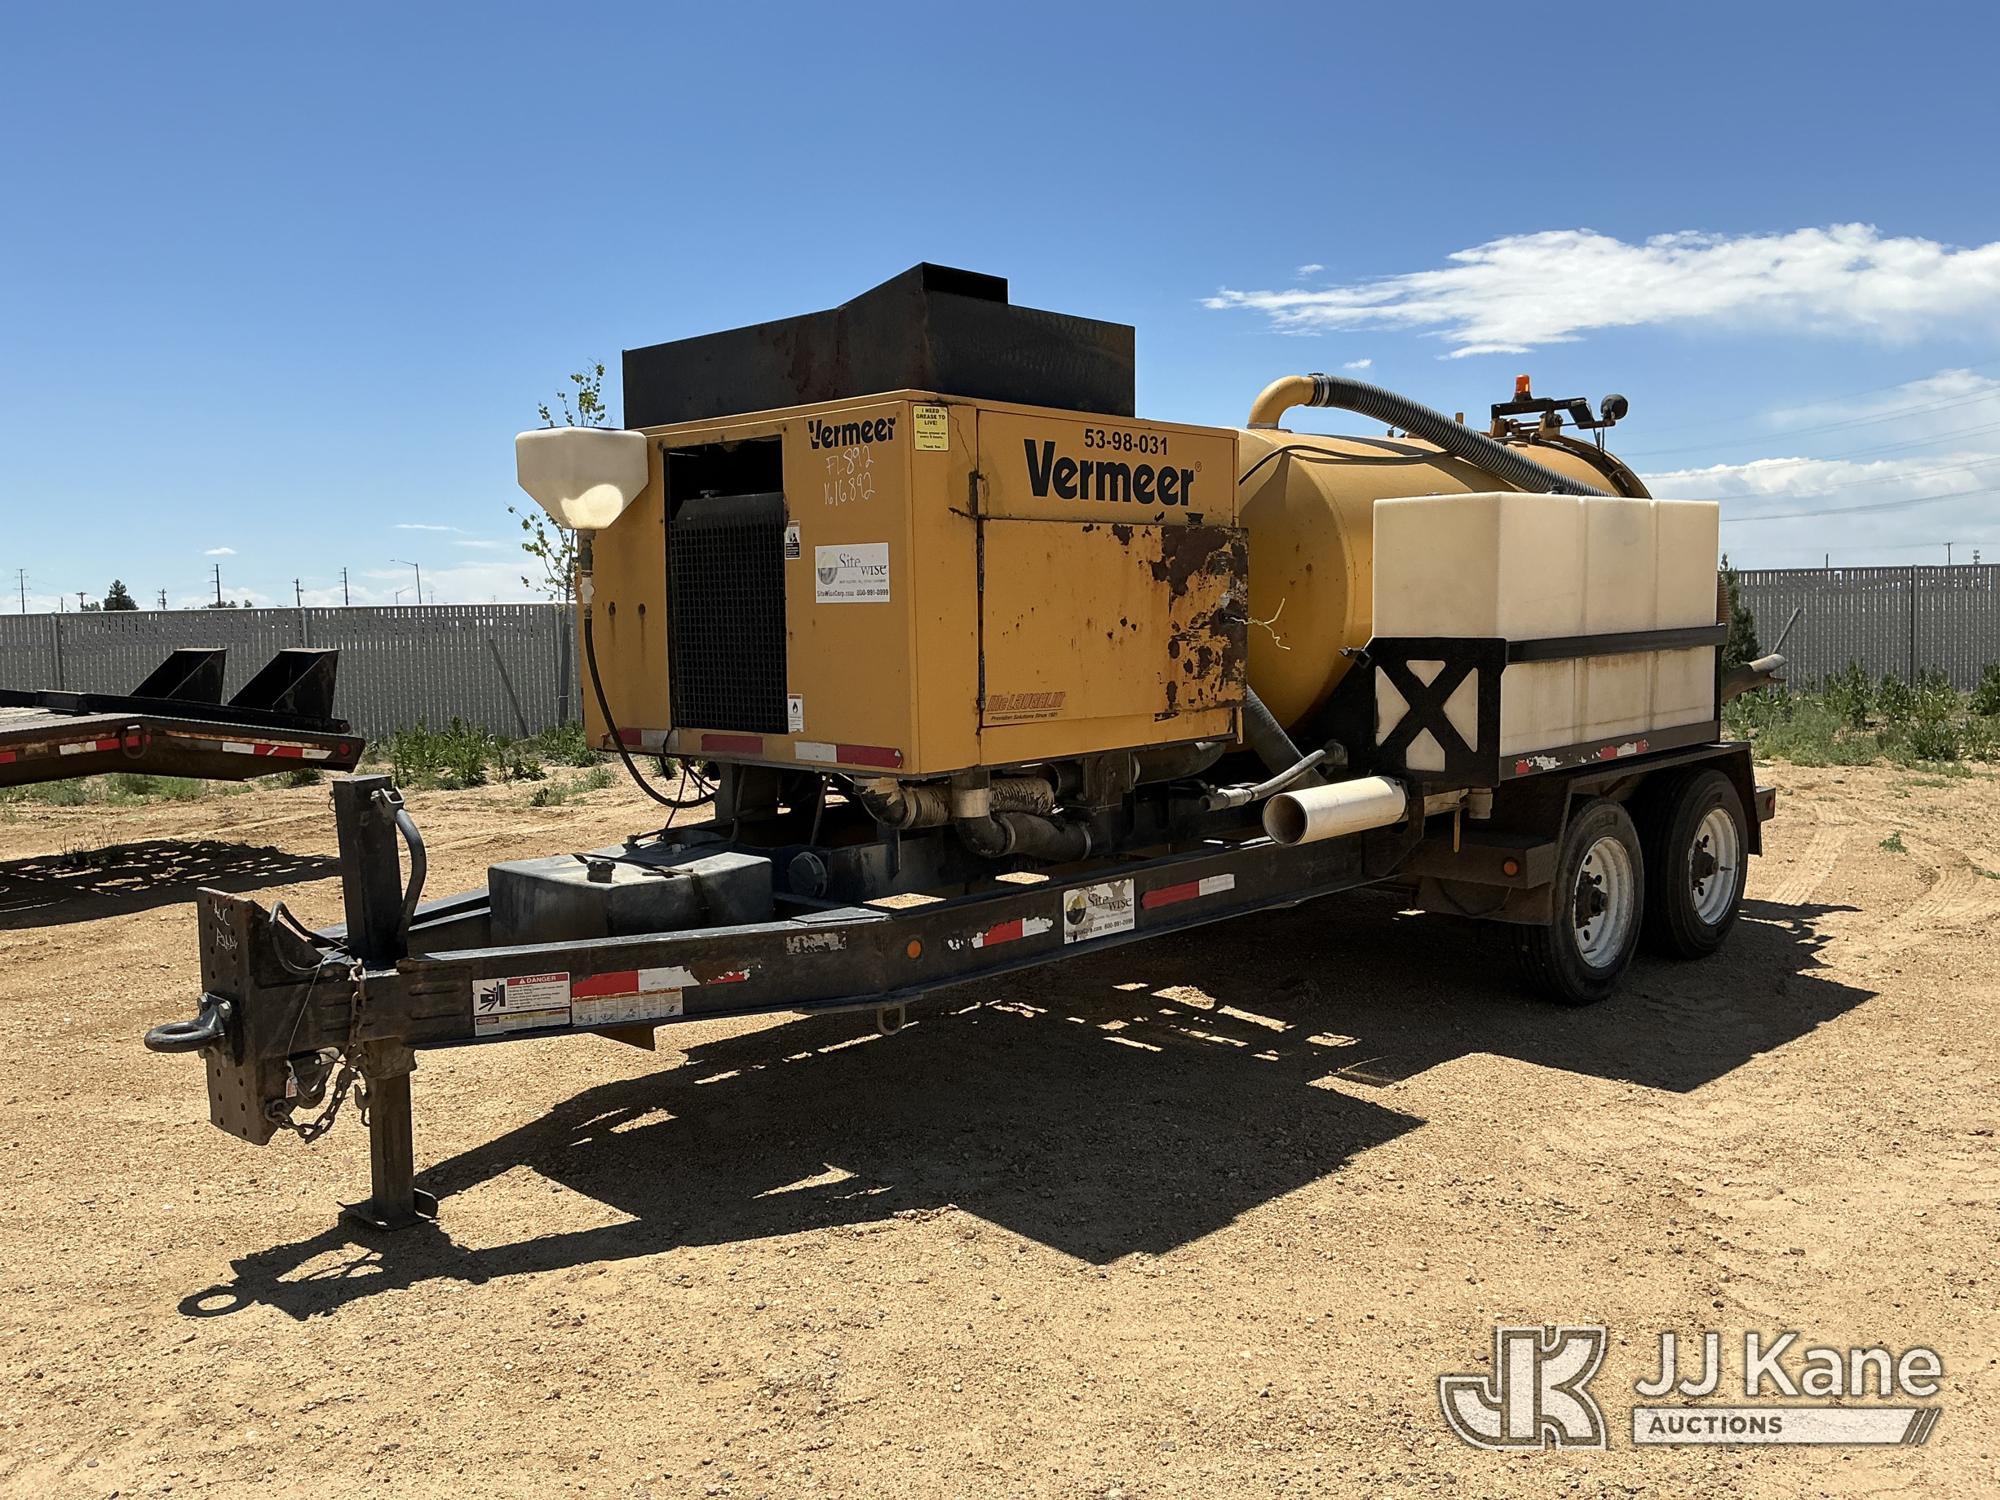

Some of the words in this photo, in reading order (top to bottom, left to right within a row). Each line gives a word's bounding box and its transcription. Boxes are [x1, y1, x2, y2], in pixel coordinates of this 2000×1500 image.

[808, 417, 896, 449] Vermeer
[1084, 428, 1168, 455] 53-98-031
[1024, 439, 1194, 506] Vermeer
[839, 552, 861, 568] Site
[860, 565, 888, 576] wise
[526, 975, 557, 984] DANGER
